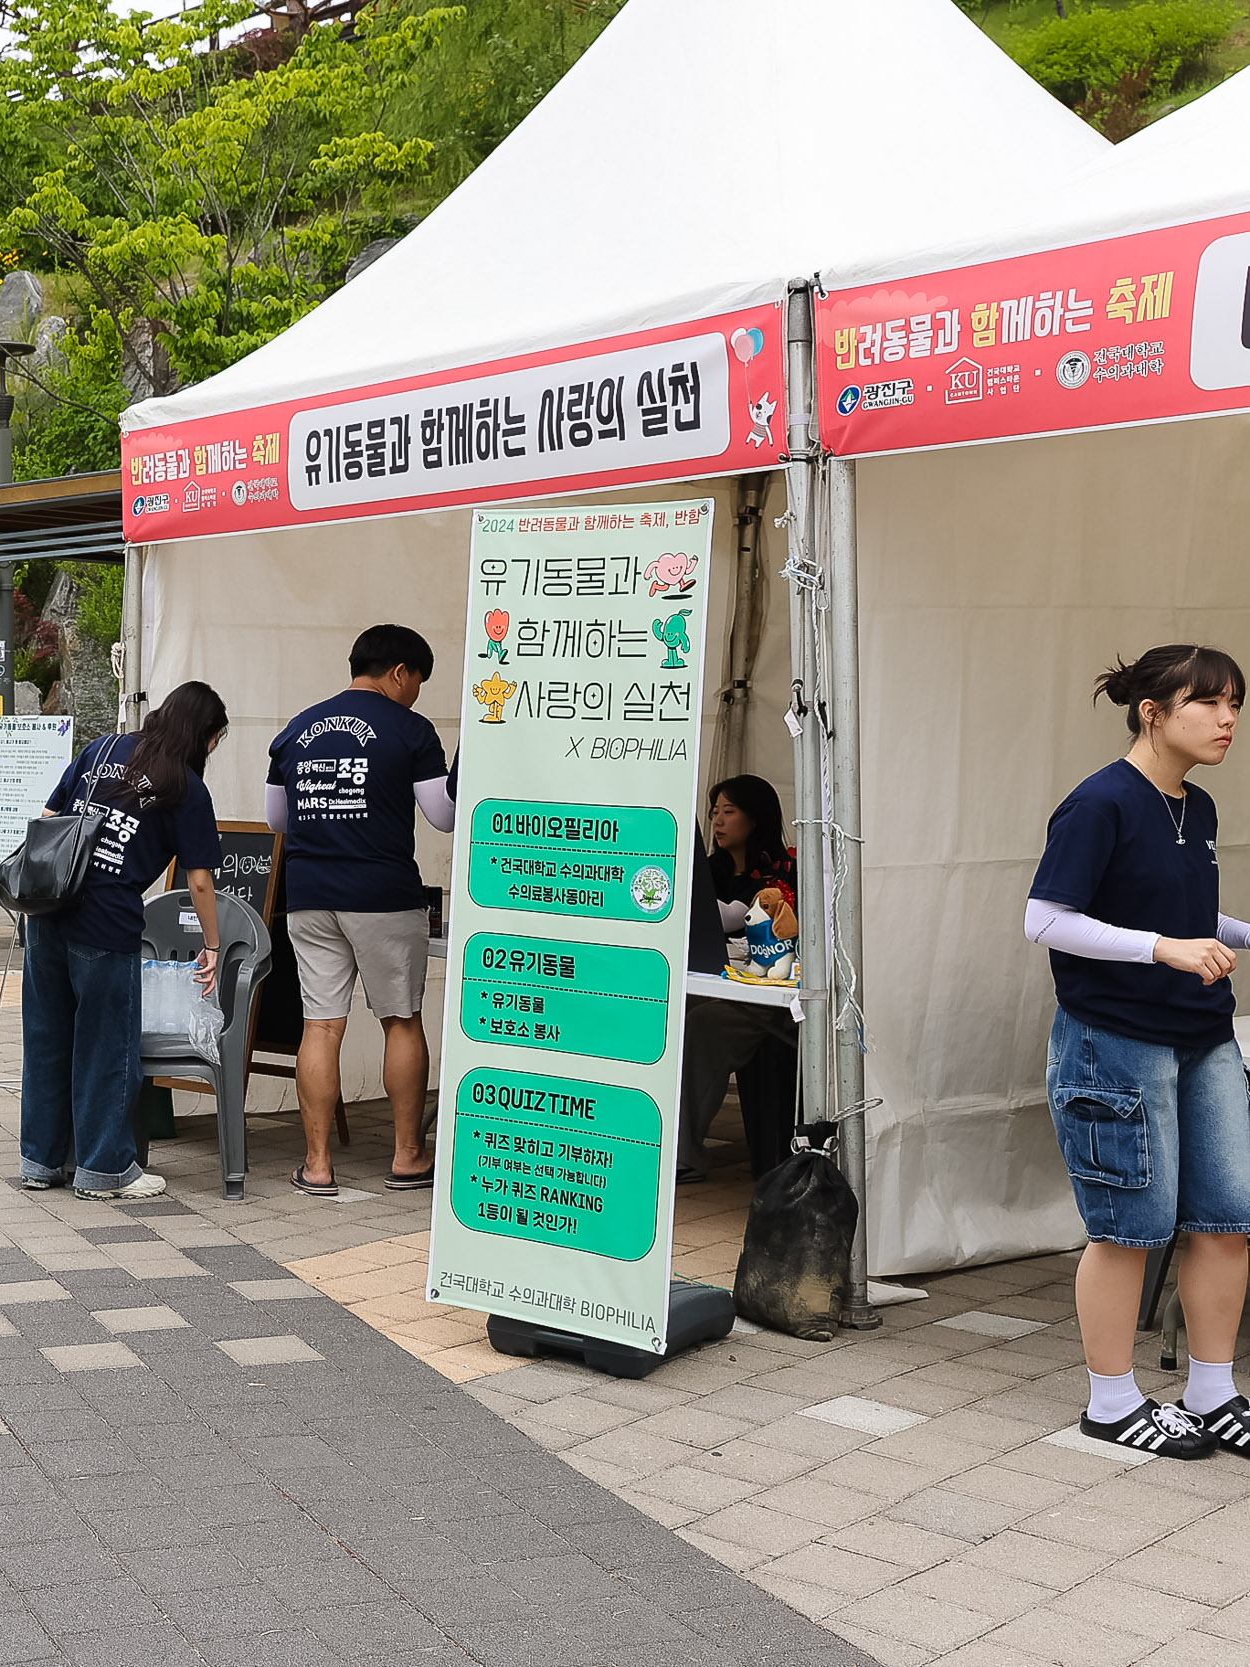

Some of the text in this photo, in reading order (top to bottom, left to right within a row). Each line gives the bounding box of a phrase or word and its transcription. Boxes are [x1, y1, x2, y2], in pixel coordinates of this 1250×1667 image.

[835, 306, 961, 370] 반려동물과
[970, 287, 1094, 348] 함께하는
[1105, 270, 1175, 325] 축제
[1093, 341, 1165, 365] 건국대학교
[950, 370, 978, 390] KU
[1093, 358, 1165, 382] 수의과대학
[862, 396, 914, 409] GWANGJIN-GU
[863, 379, 914, 400] 광진구
[305, 361, 703, 487] 유기동물과 함께하는 사랑의 실천
[131, 432, 281, 486] 반려동물과 함께하는 축제
[185, 490, 198, 503] KU
[481, 509, 702, 533] 2024 반려동물과 함께하는 축제, 반함
[479, 556, 642, 597] 유기동물과
[516, 618, 648, 659] 함께하는
[513, 680, 691, 722] 사랑의 실천
[296, 715, 377, 748] KONKUK
[565, 736, 688, 761] X BIOPHILIA
[337, 758, 369, 785] 조공
[297, 797, 328, 810] MARS
[338, 787, 365, 795] chogong
[105, 808, 141, 843] 조공
[100, 837, 125, 852] chogong
[500, 858, 625, 884] 건국대학교 수의과대학
[508, 884, 605, 908] 수의료봉사동아리
[491, 994, 545, 1014] 유기동물
[490, 1018, 561, 1042] 보호소 봉사
[484, 1131, 613, 1169] 퀴즈 맞히고 기부하자!
[478, 1155, 607, 1190] (기부 여부는 선택 가능합니다)
[481, 1176, 604, 1213] 누가 퀴즈 RANKING
[478, 1201, 577, 1235] 1등이 될 것인가!
[440, 1271, 656, 1333] 건국대학교 수의과대학 BIOPHILIA
